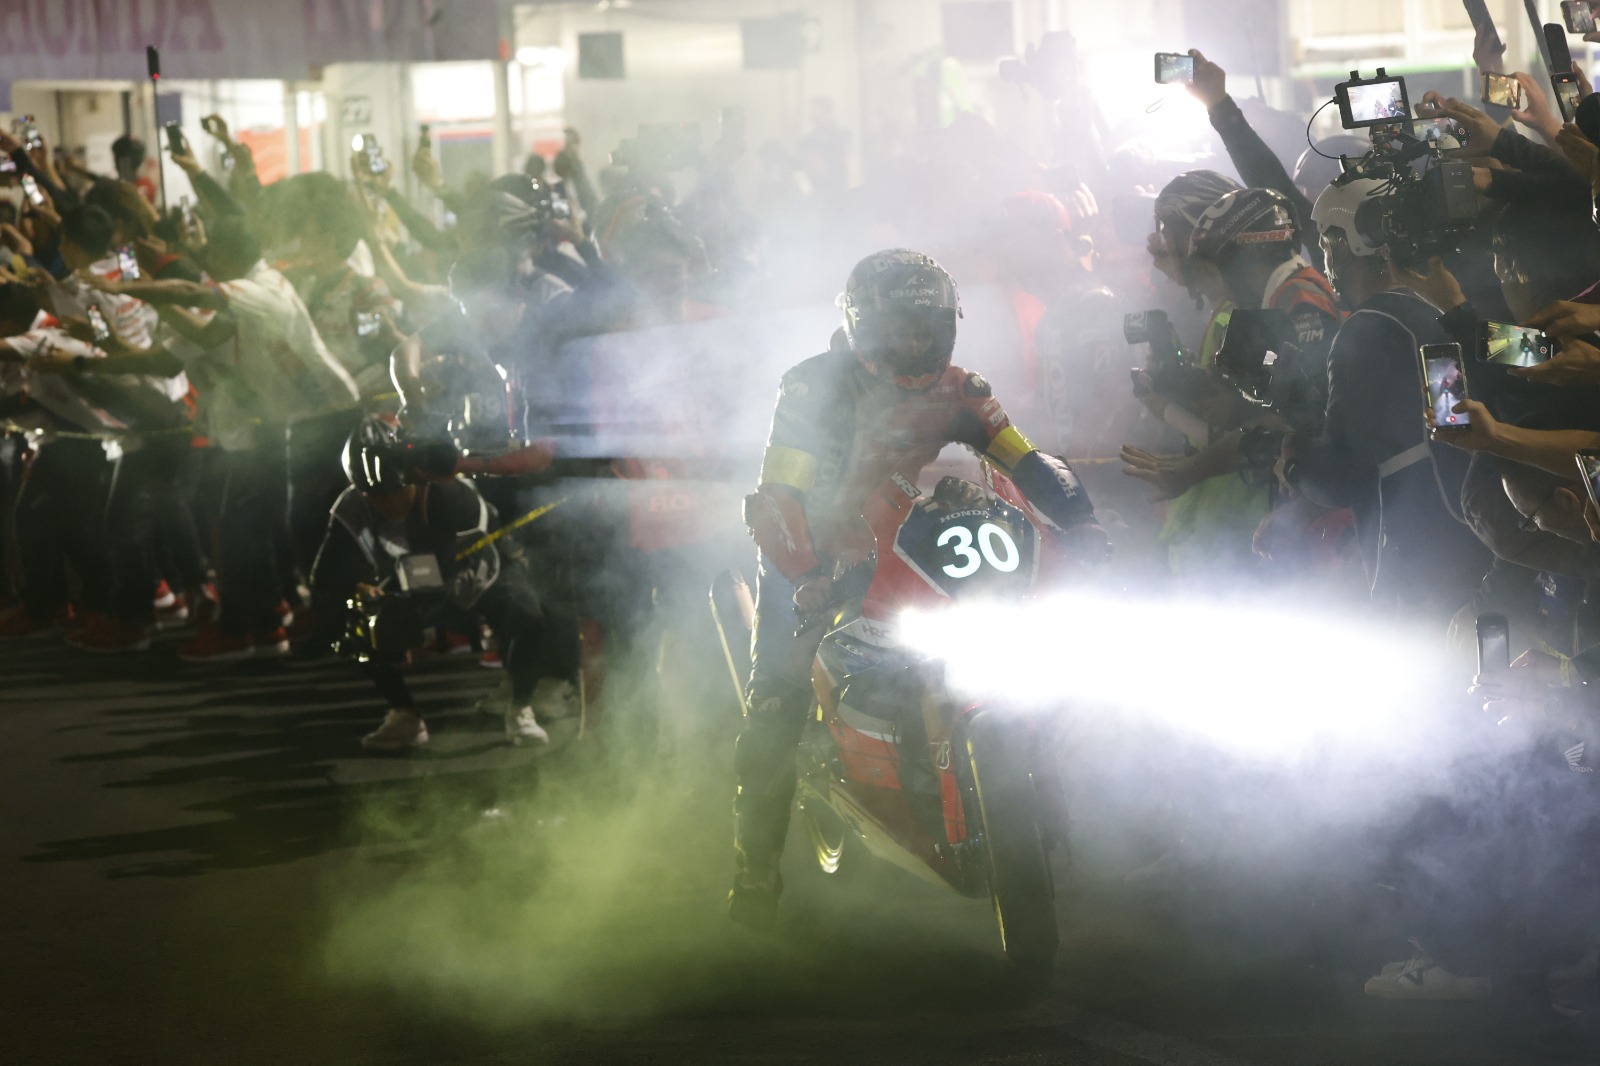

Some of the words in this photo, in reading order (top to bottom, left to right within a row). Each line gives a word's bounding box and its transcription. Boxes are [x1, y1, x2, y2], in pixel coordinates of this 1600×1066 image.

[889, 288, 936, 299] SHARK
[890, 471, 921, 498] WRS
[940, 509, 991, 523] HONDA
[937, 523, 1020, 578] 30
